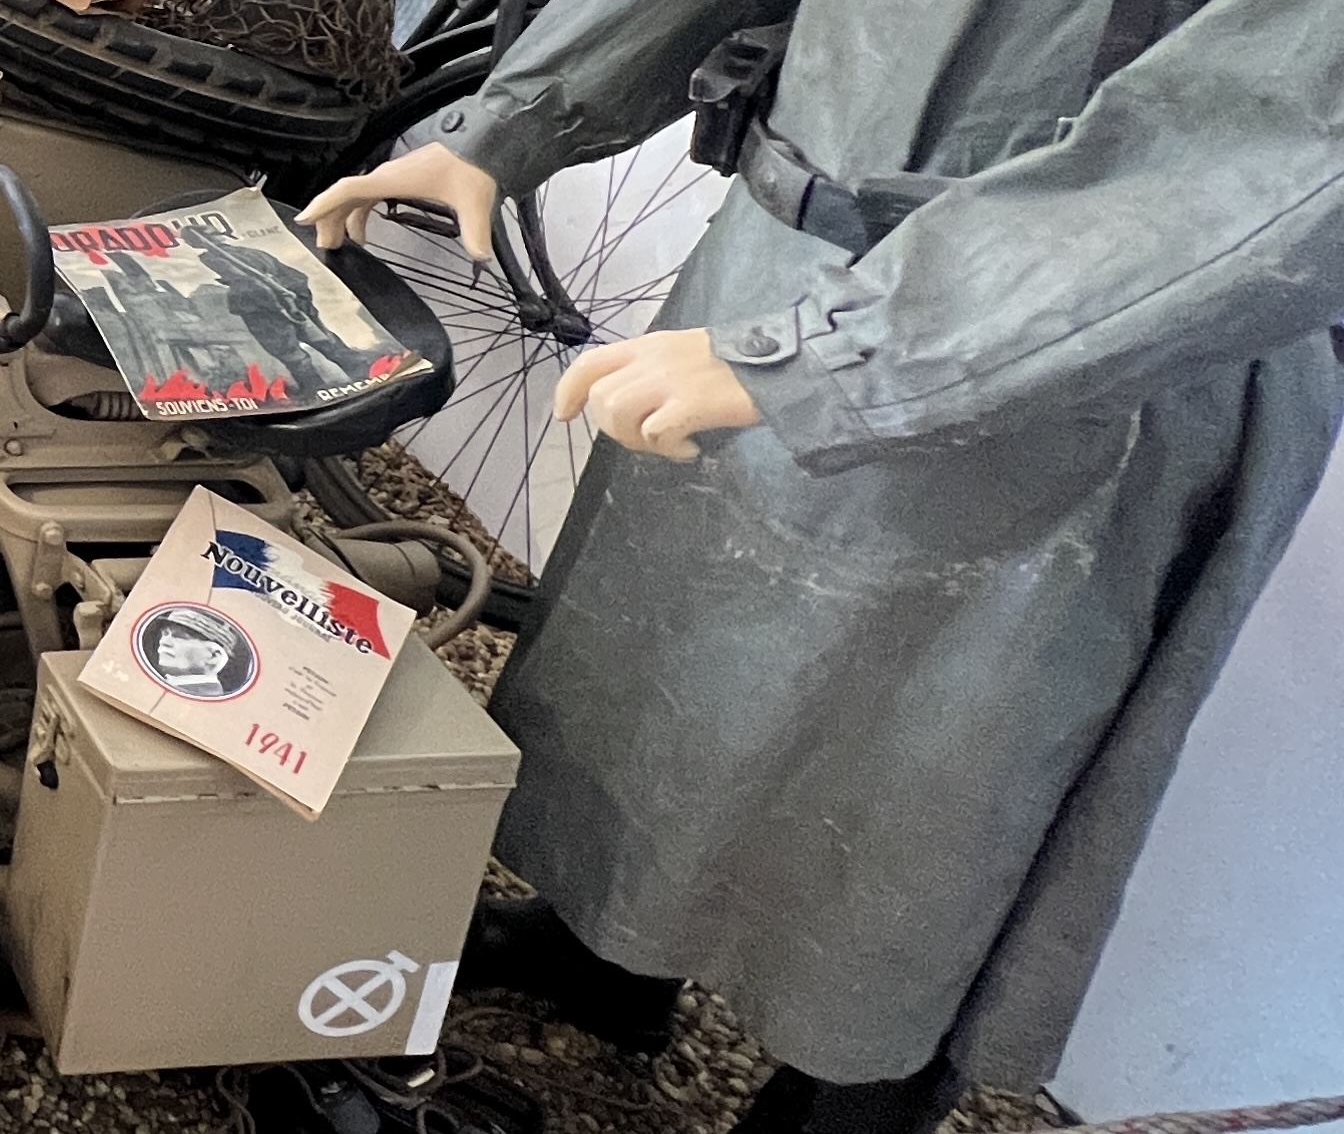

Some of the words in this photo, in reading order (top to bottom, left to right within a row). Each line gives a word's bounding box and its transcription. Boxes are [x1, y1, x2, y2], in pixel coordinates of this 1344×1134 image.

[156, 397, 260, 417] SOUVIENS-TOI
[201, 541, 374, 654] Nouvelliste
[244, 723, 308, 774] 1941
